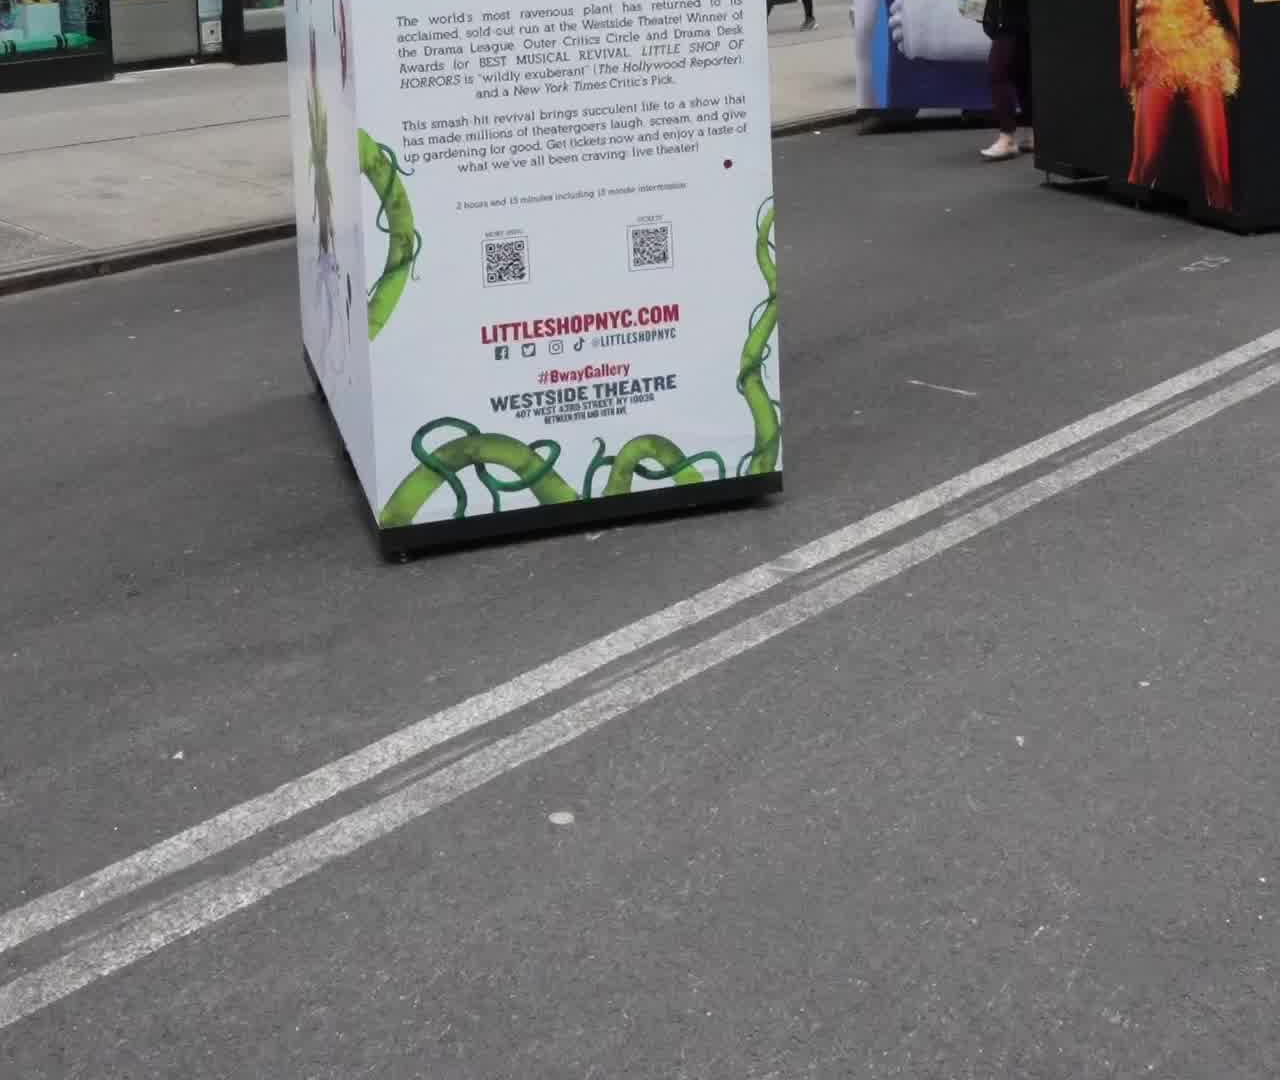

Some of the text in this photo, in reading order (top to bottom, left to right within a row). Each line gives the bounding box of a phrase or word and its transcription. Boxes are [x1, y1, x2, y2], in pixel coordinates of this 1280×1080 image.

[482, 9, 510, 20] most
[520, 7, 573, 18] ravenous
[583, 3, 612, 16] plant
[582, 16, 632, 29] Westside
[423, 27, 710, 56] Drama Drama
[399, 44, 680, 74] Awards MUSICAL LITTLE
[400, 57, 686, 88] HORRORS Hollywood
[582, 103, 636, 116] succulent
[532, 119, 606, 135] theatergoers
[423, 146, 485, 162] gardening
[480, 304, 679, 344] LITTLESHOPNYC.COM
[537, 363, 630, 384] #BwayGallery
[490, 374, 677, 412] WESTSIDE THEATRE
